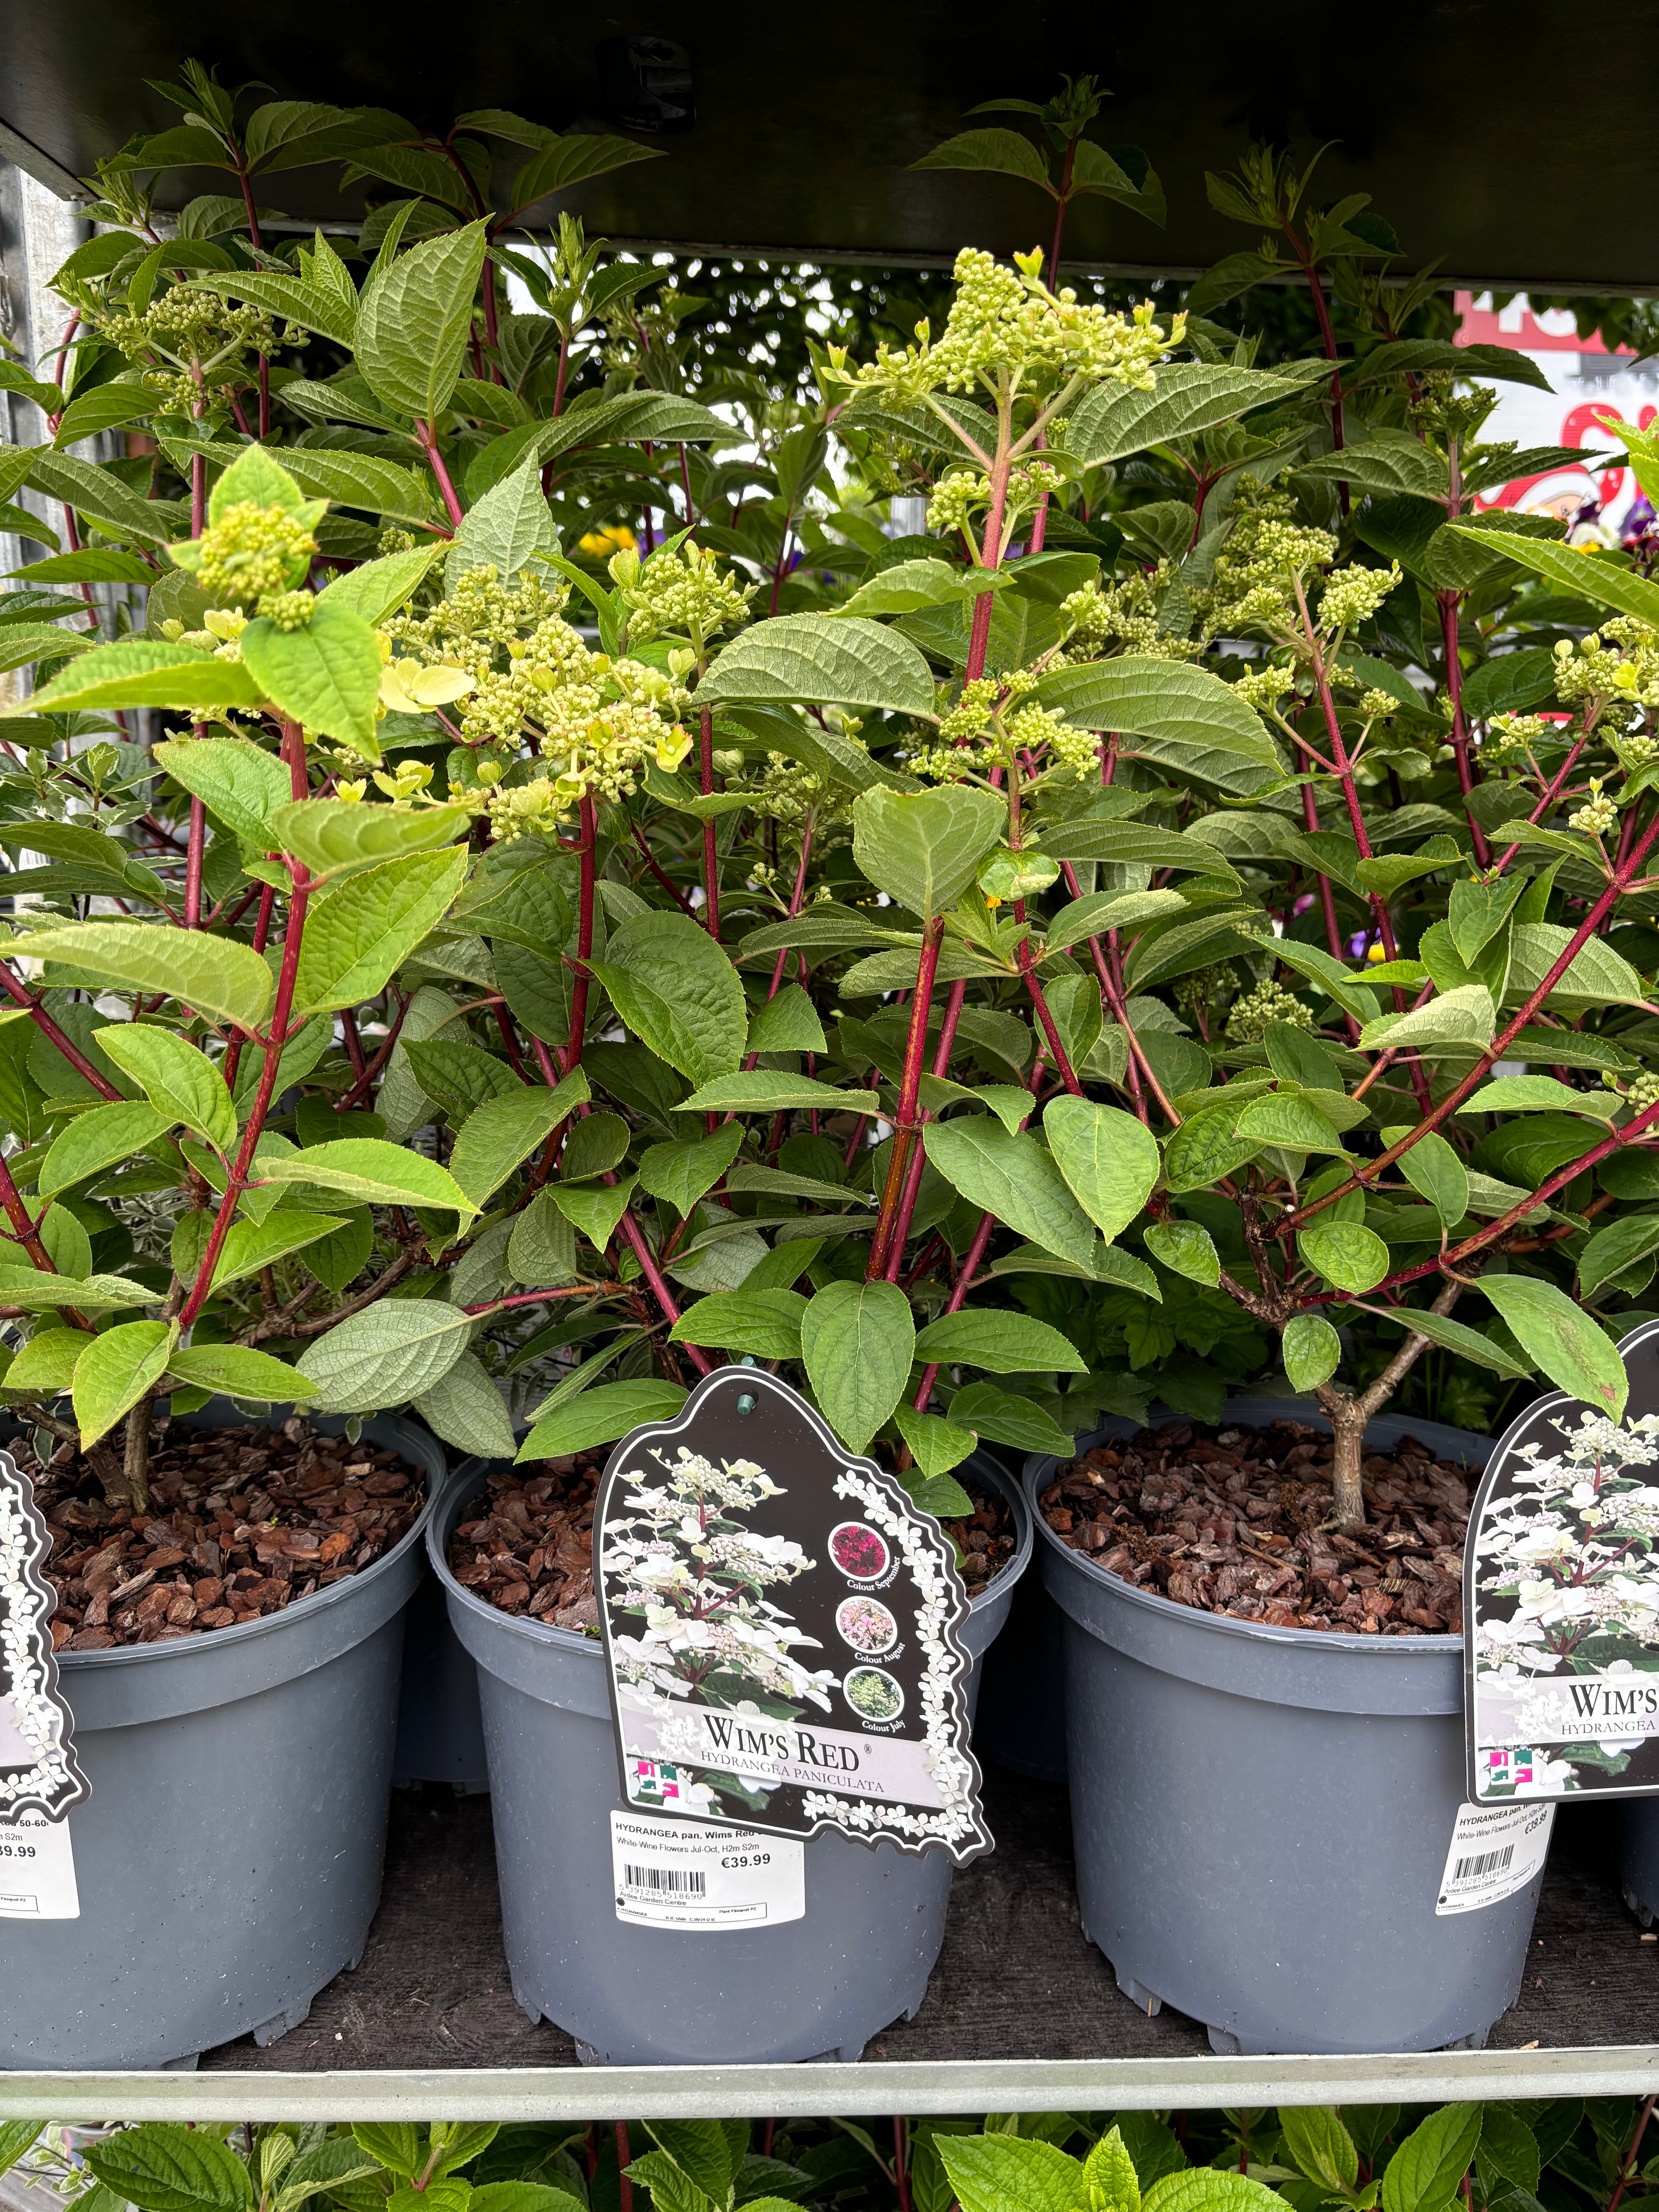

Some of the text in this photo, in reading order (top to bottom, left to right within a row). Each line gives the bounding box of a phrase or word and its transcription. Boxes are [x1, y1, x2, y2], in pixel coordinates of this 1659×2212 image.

[847, 1556, 901, 1591] Colour September
[855, 1643, 906, 1664] Colour August
[862, 1719, 906, 1734] Colour July
[1561, 1720, 1656, 1735] HYDRANGEA
[701, 1751, 885, 1793] HYDRANGEA PANICULATA
[1459, 1806, 1522, 1826] HYDRANGEA pan.
[1524, 1810, 1548, 1834] €39.99
[5, 1833, 23, 1841] S2m
[616, 1822, 679, 1838] HYDRANGEA
[1457, 1829, 1490, 1840] White-Wine
[1491, 1823, 1511, 1834] Flowers
[617, 1836, 658, 1850] White-Wine
[659, 1843, 689, 1853] Flowers
[691, 1845, 720, 1853] Jul-Oct,
[722, 1844, 740, 1853] H2m
[721, 1853, 771, 1869] €39.99
[1454, 1877, 1481, 1887] 391285
[1485, 1867, 1508, 1880] 518690
[1481, 1879, 1496, 1888] Centre
[620, 1891, 638, 1900] Ardee
[639, 1896, 663, 1904] Garden
[629, 1886, 662, 1897] 391285
